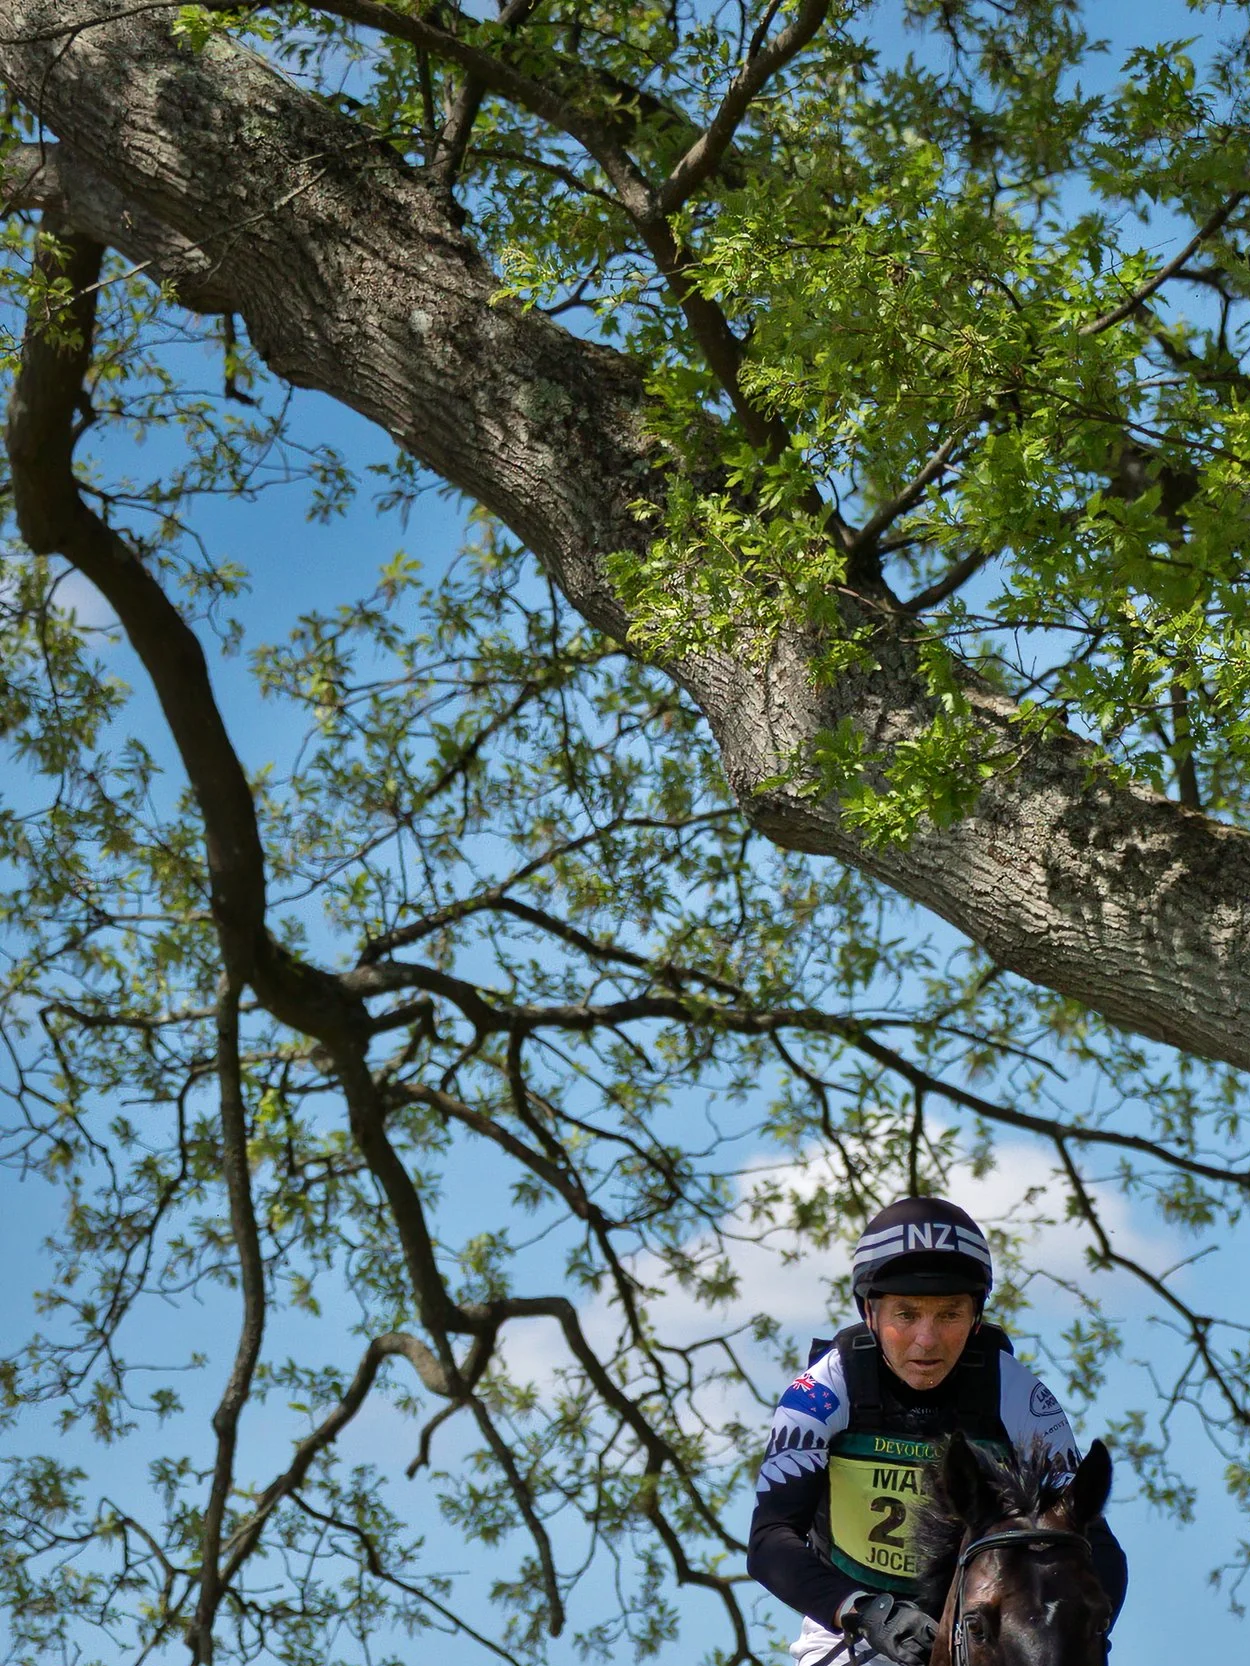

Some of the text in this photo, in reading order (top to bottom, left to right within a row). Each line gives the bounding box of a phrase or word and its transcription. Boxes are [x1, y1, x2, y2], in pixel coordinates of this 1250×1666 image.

[907, 1222, 955, 1251] NZ
[872, 1468, 926, 1496] MA
[868, 1496, 906, 1549] 2
